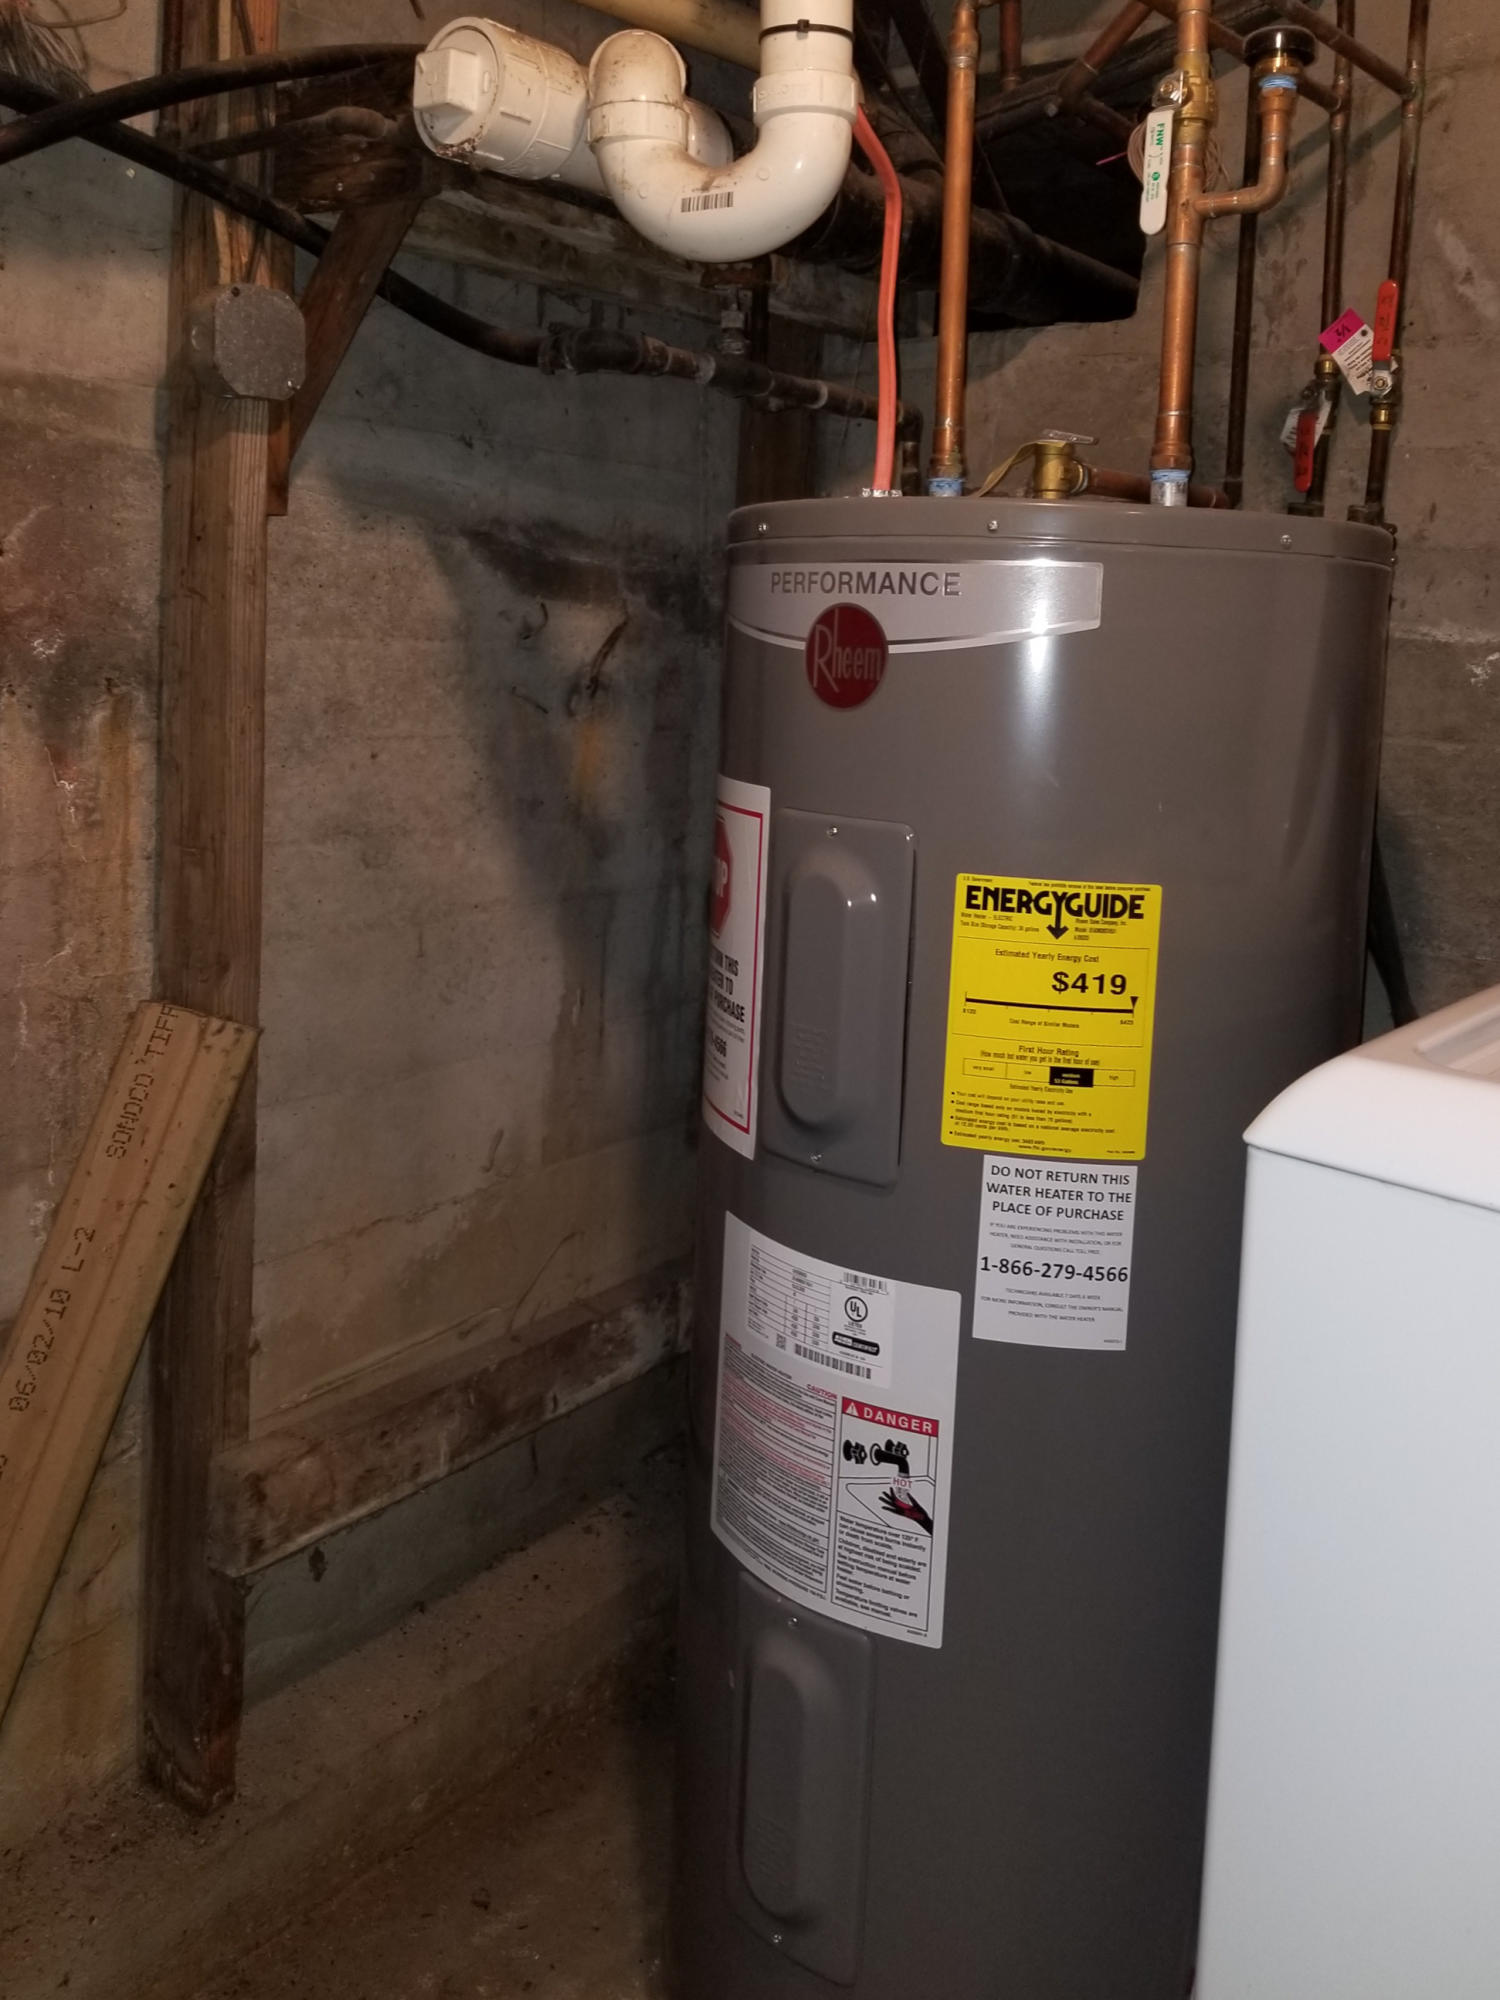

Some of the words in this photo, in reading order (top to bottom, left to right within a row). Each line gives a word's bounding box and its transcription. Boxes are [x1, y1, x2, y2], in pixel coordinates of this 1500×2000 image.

[771, 571, 962, 596] PERFORMANCE
[813, 607, 882, 694] Rheem
[965, 885, 1145, 919] ENERGYGUIDE
[995, 949, 1030, 958] Estimated
[1032, 952, 1055, 961] Yearly
[1058, 953, 1081, 963] Energy
[1052, 971, 1127, 995] $419
[1019, 1045, 1035, 1054] First
[1037, 1047, 1054, 1055] Hour
[1056, 1048, 1079, 1057] Rating
[991, 1165, 1011, 1176] DO
[1014, 1168, 1042, 1180] NOT
[1046, 1170, 1098, 1184] RETURN
[1102, 1174, 1130, 1185] THIS
[986, 1182, 1031, 1197] WATER
[1035, 1188, 1084, 1201] HEATER
[1088, 1191, 1104, 1202] TO
[1108, 1192, 1132, 1203] THE
[992, 1201, 1032, 1215] PLACE
[1035, 1205, 1053, 1216] OF
[1056, 1207, 1124, 1220] PURCHASE
[8, 1288, 71, 1412] 06/02/10
[61, 1226, 95, 1272] L-2
[105, 1073, 154, 1159] SONOCO
[980, 1256, 1128, 1282] 1-866-279-4566
[864, 1407, 932, 1433] DANGER
[892, 1477, 913, 1488] HOT
